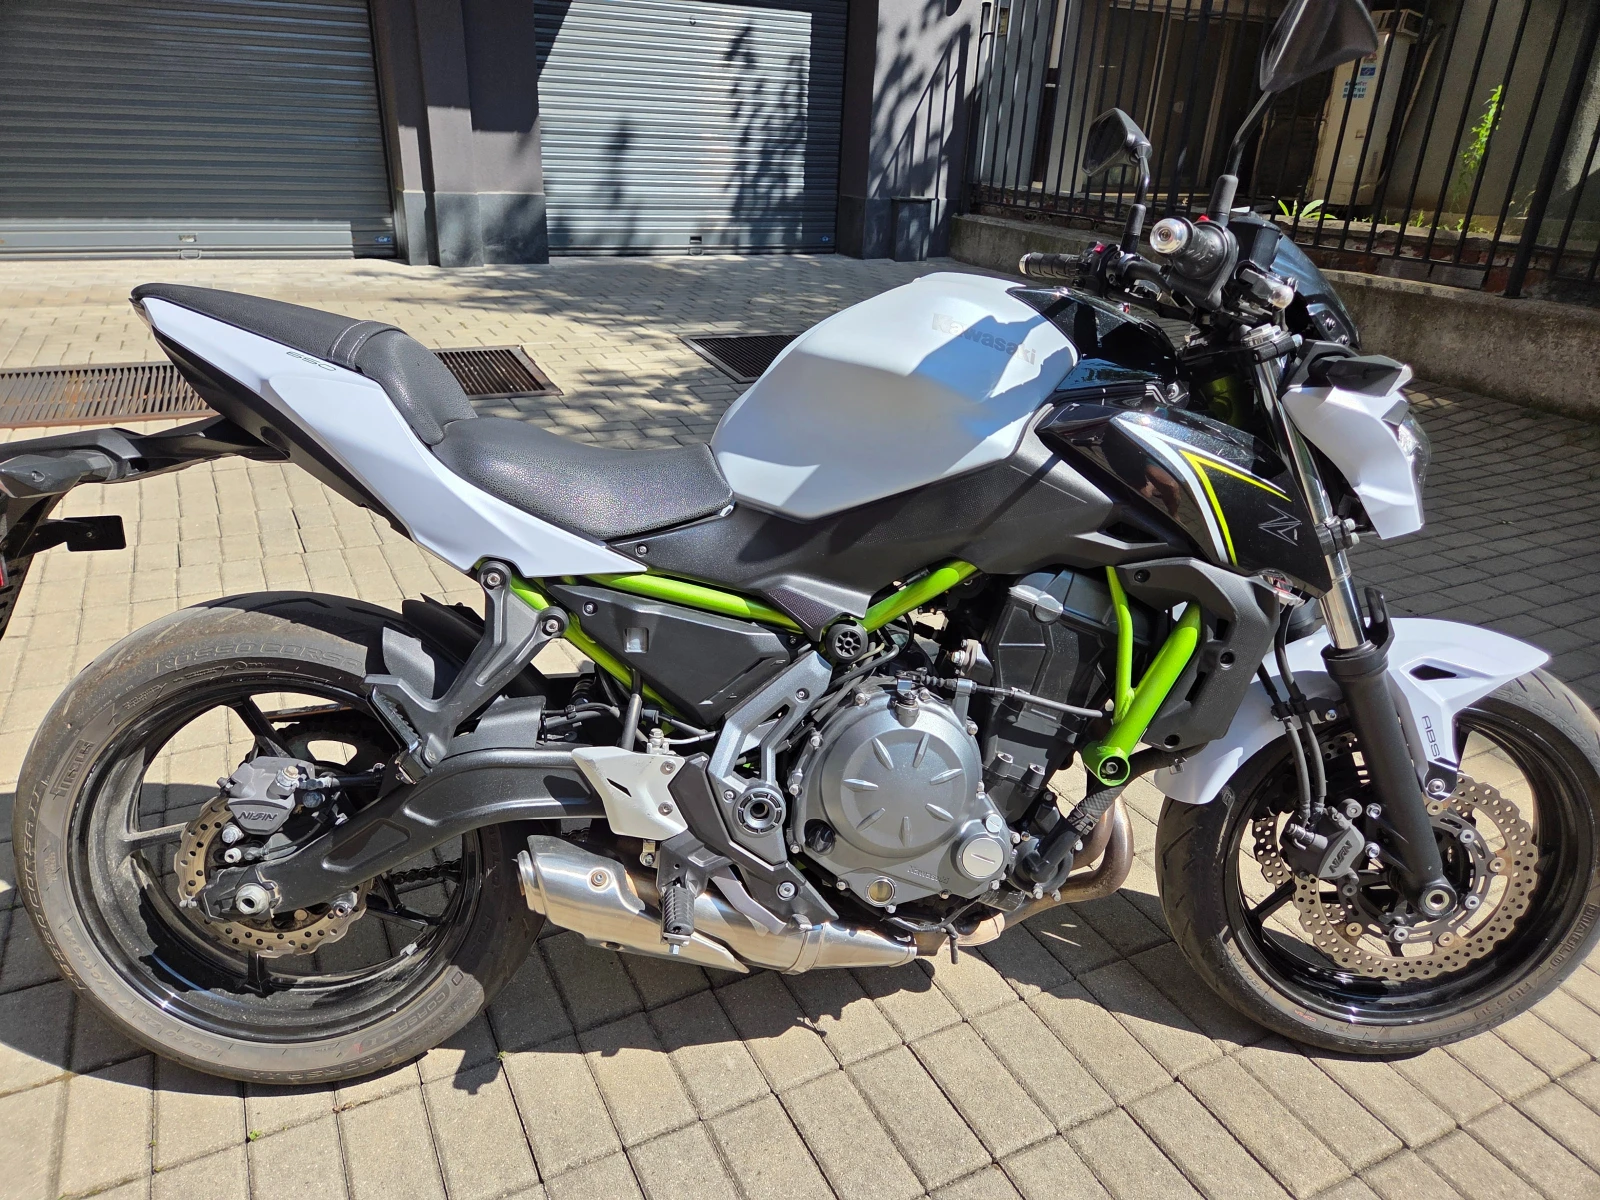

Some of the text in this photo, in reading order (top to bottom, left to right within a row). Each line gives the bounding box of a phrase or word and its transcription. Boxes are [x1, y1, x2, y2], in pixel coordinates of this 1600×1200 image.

[932, 313, 1036, 365] Kawasaki
[156, 642, 256, 673] ROSSO
[259, 642, 364, 669] CORSA
[1421, 715, 1440, 757] ABS
[23, 821, 40, 908] CORSA
[35, 911, 87, 990] ROSSO
[1551, 903, 1599, 968] DIABLO
[396, 992, 446, 1031] CORSA
